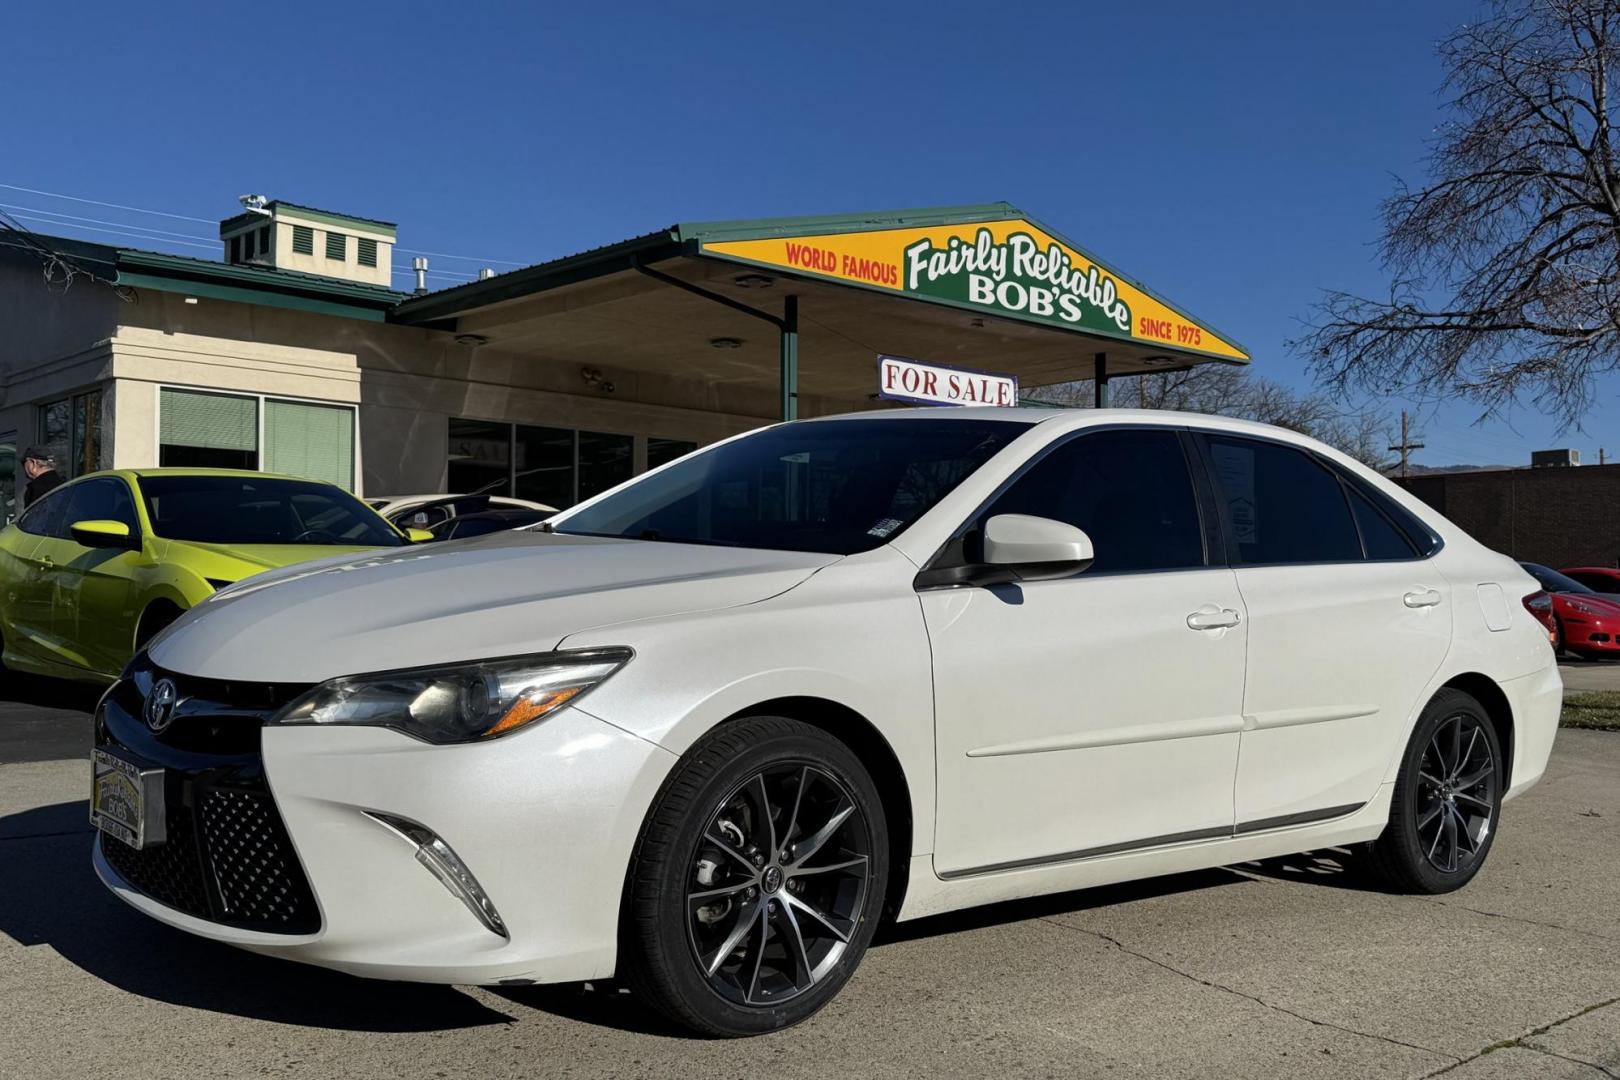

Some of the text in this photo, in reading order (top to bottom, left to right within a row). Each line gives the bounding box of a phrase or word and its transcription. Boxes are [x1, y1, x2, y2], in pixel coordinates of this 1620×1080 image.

[786, 242, 898, 285] WORLD FAMOUS
[908, 231, 1130, 331] Fairly Reliable
[969, 274, 1082, 322] BOB'S
[1140, 317, 1201, 346] SINCE 1975
[886, 364, 1011, 407] FOR SALE
